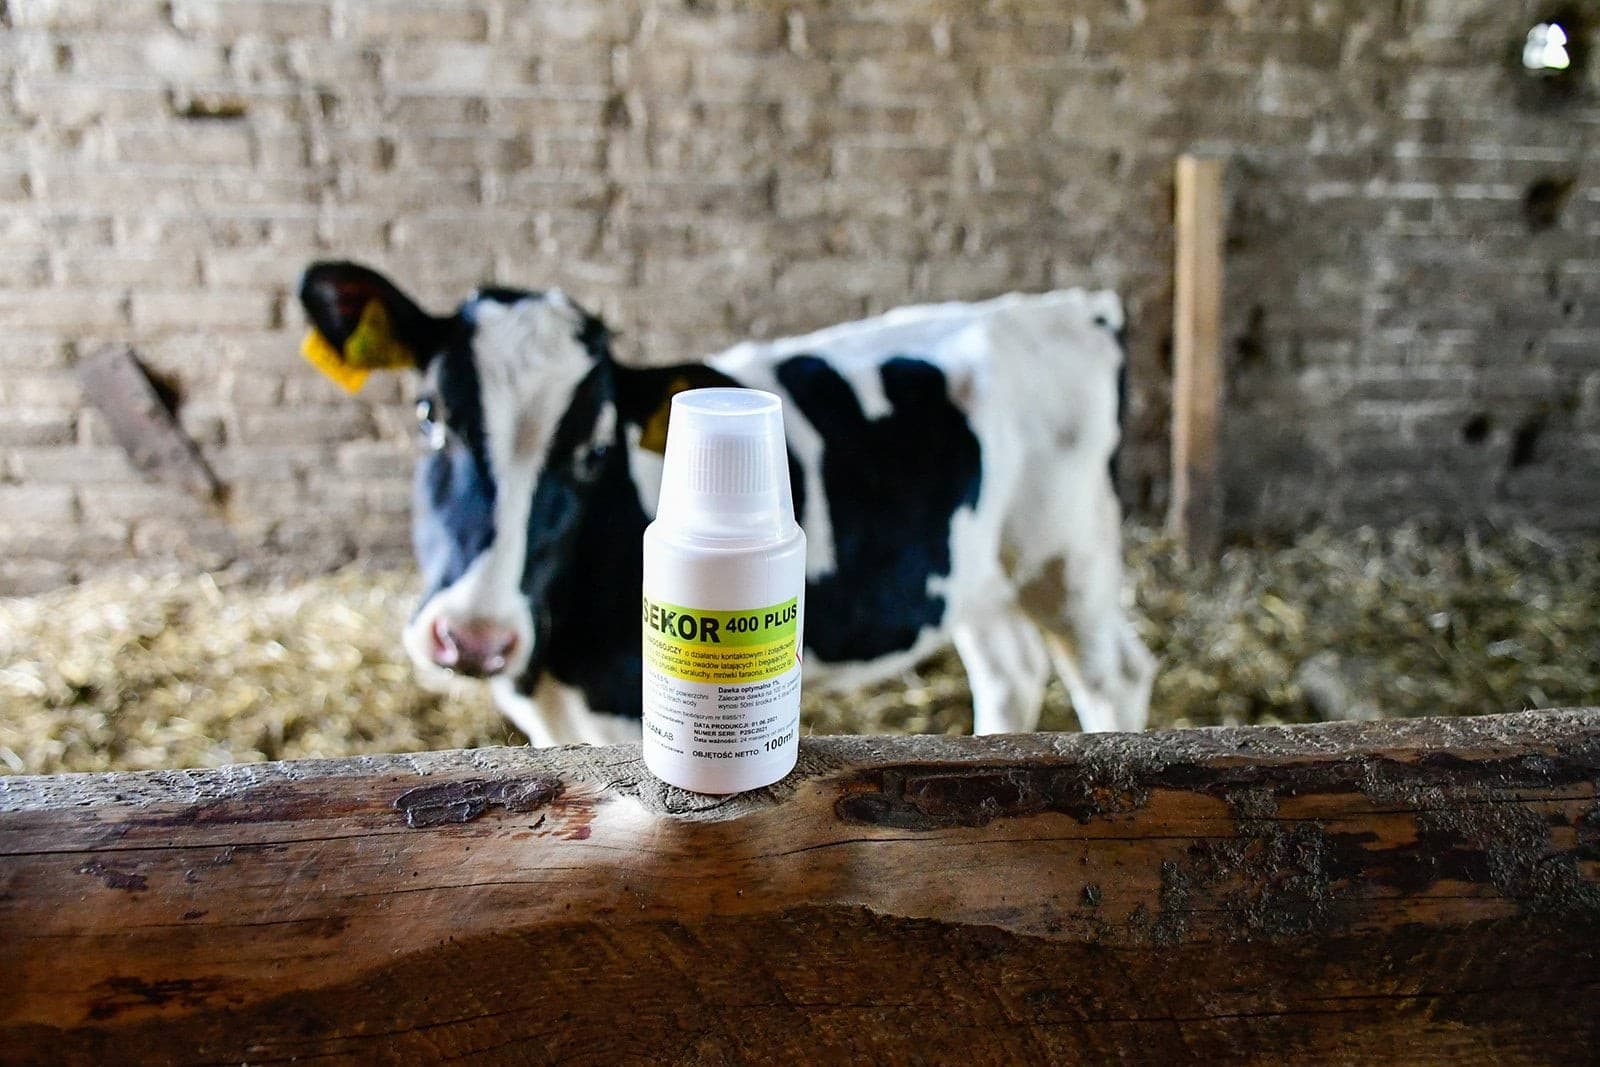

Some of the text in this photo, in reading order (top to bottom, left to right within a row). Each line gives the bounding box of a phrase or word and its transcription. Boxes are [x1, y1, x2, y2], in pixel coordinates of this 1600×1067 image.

[726, 617, 758, 633] 400
[765, 604, 797, 629] PLUS
[720, 651, 764, 661] kontaktowym
[692, 660, 719, 670] owadów
[720, 661, 754, 671] latających
[713, 671, 738, 679] mrówki
[718, 685, 740, 695] Dawka
[740, 682, 771, 695] optymalna
[718, 692, 746, 702] Zalecana
[718, 701, 738, 711] wynosi
[739, 700, 754, 710] 50ml
[694, 722, 710, 731] DATA
[694, 730, 716, 739] NUMER
[692, 728, 794, 760] OBJĘTOŚĆ NETTO 100ml
[693, 736, 708, 744] Data
